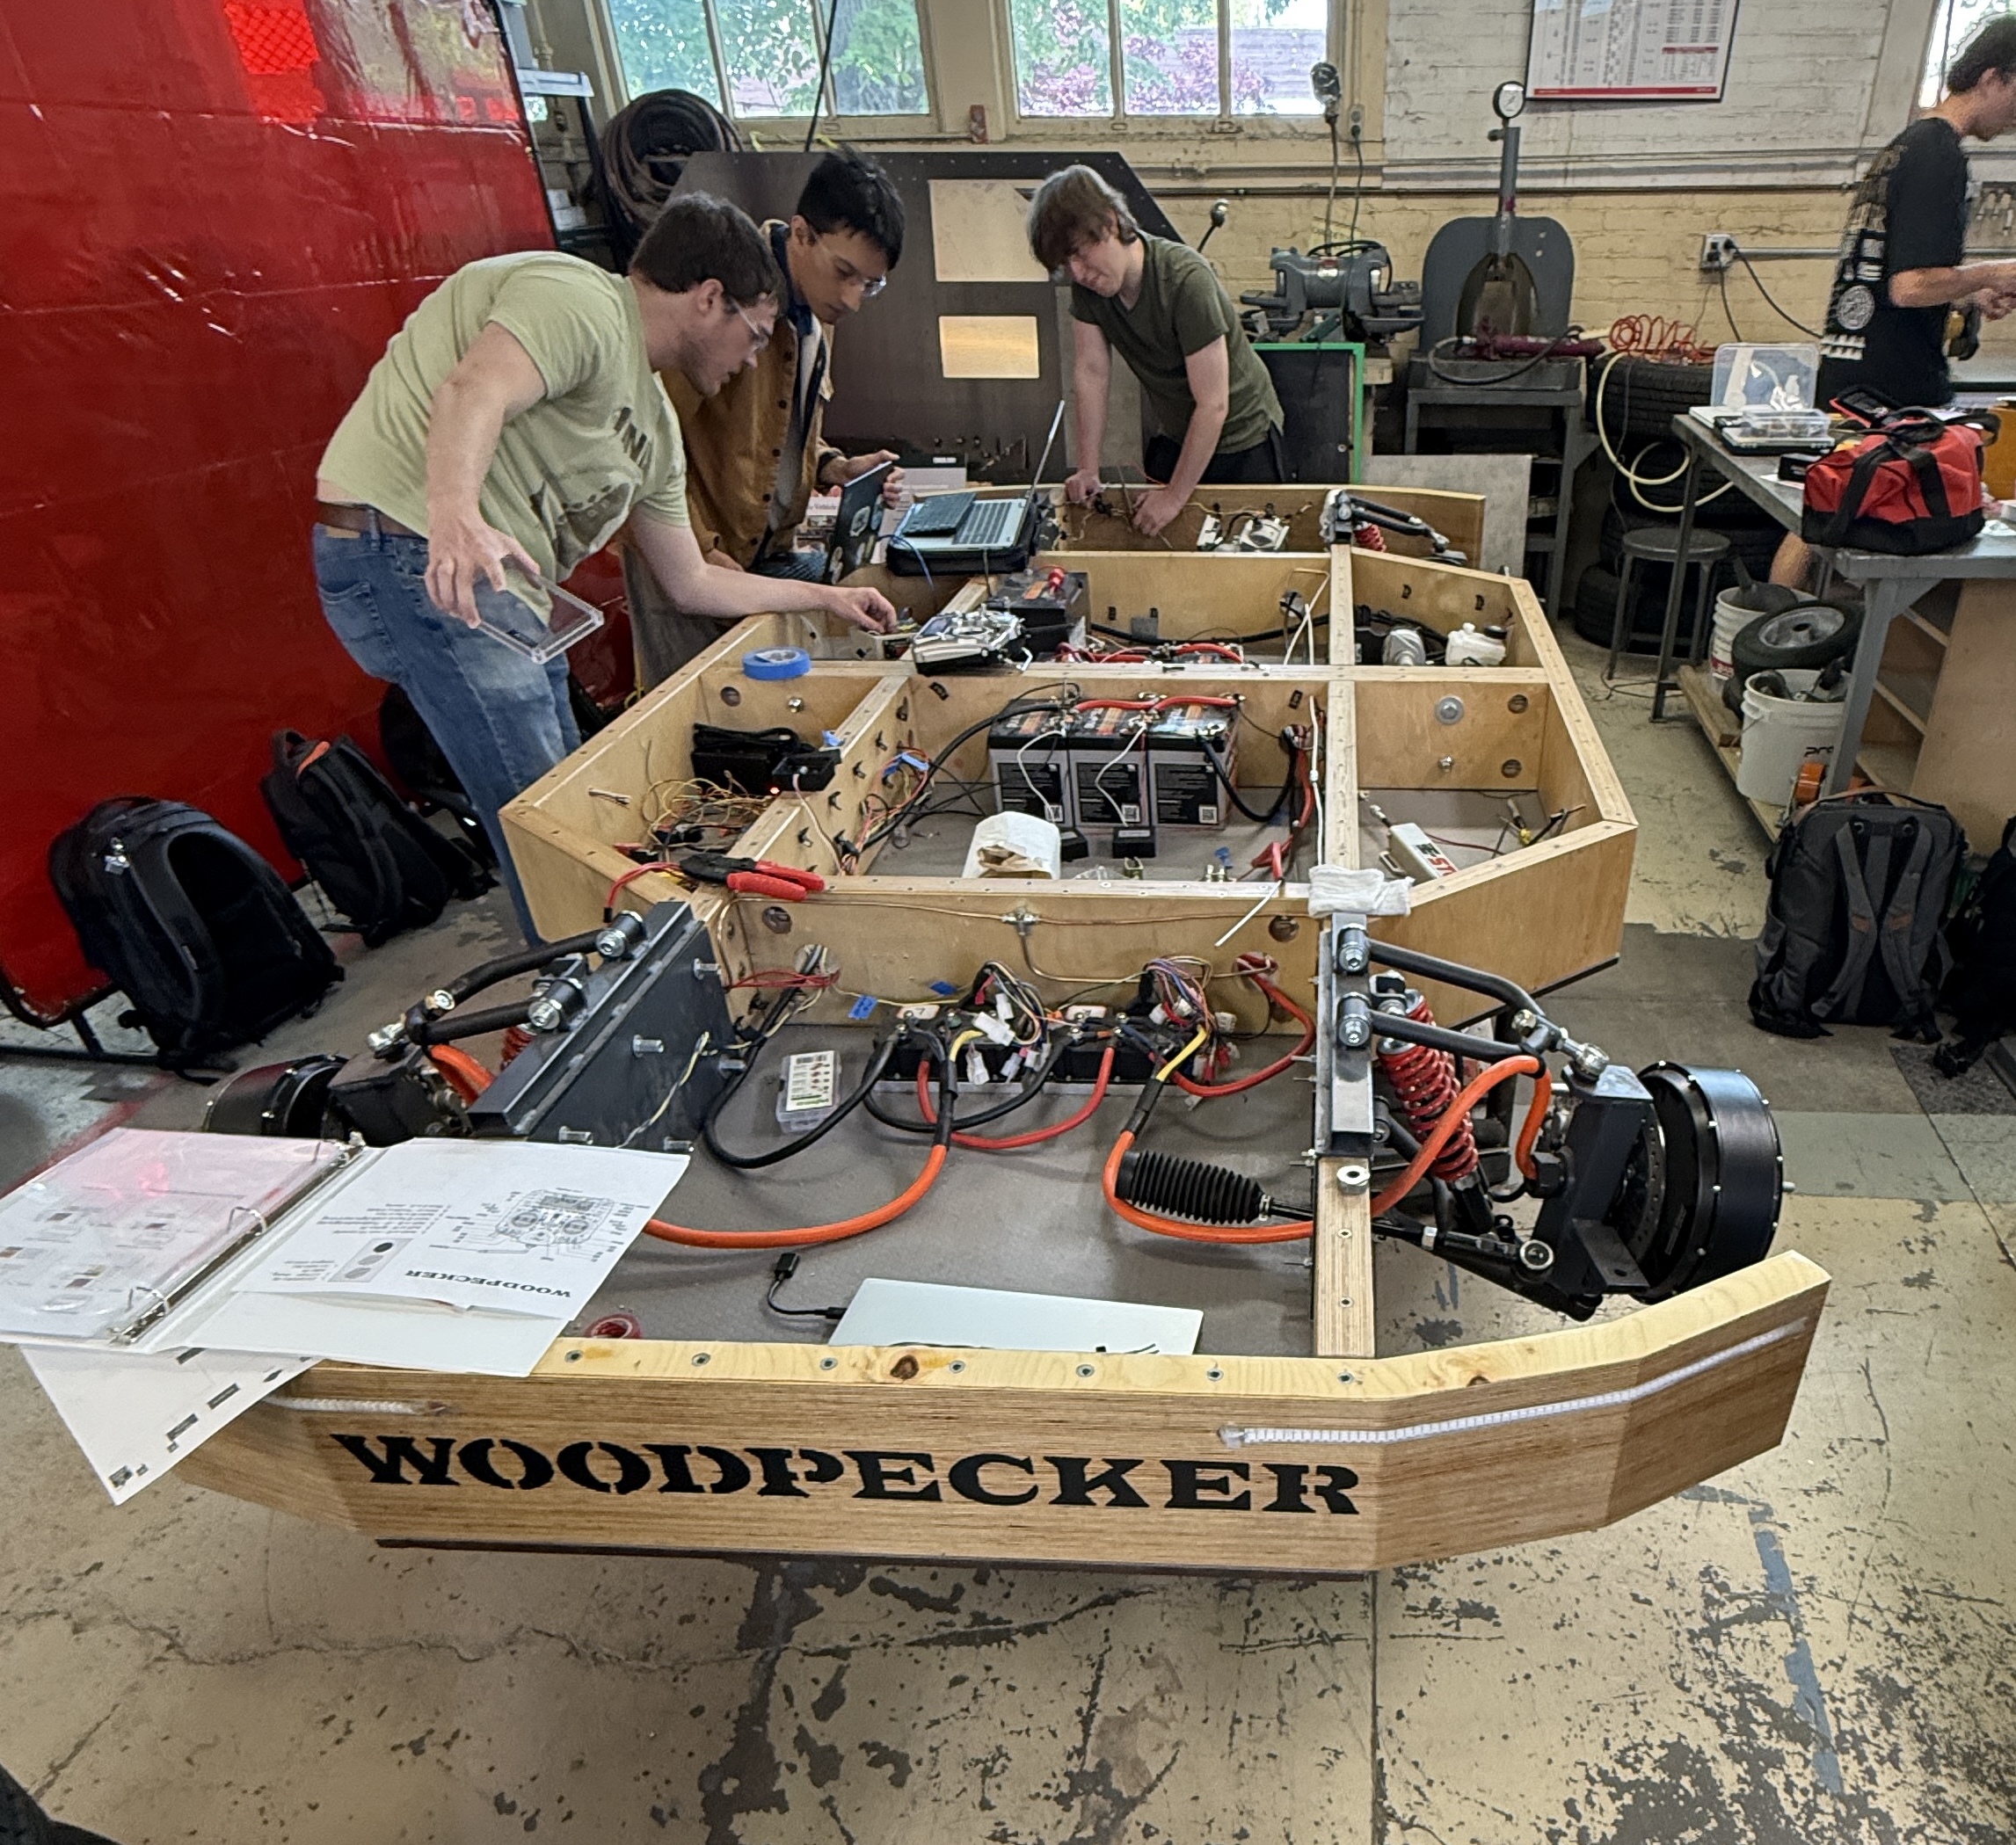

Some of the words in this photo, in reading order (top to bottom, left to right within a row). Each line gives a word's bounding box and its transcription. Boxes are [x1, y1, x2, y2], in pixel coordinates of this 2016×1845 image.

[1415, 842, 1459, 877] E-ST
[404, 1270, 571, 1297] WOODPECKER
[329, 1434, 1358, 1514] WOODPECKER
